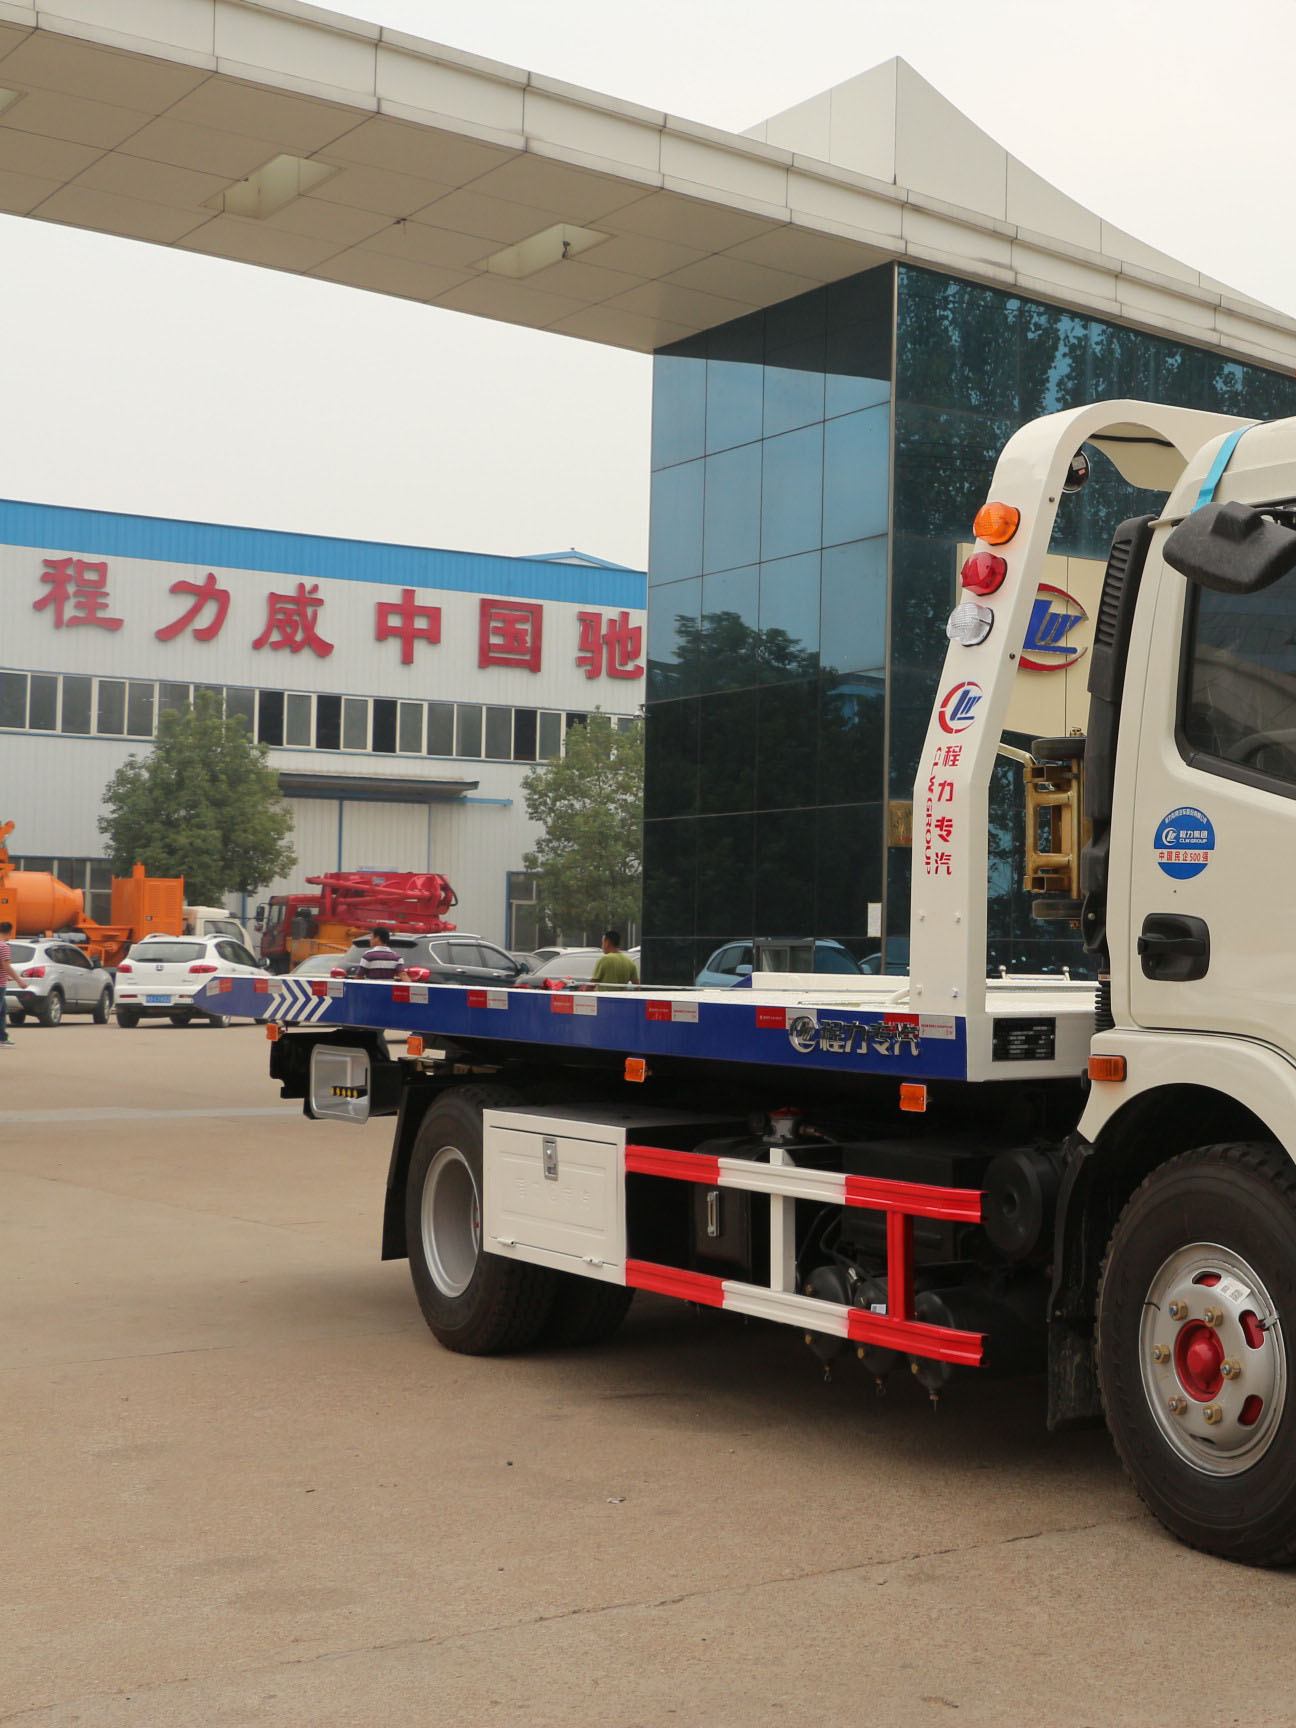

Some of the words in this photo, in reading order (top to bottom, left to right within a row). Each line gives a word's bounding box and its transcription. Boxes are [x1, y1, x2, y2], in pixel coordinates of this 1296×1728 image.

[33, 557, 644, 680] 程力威中国驰
[820, 1019, 921, 1056] 程力专汽
